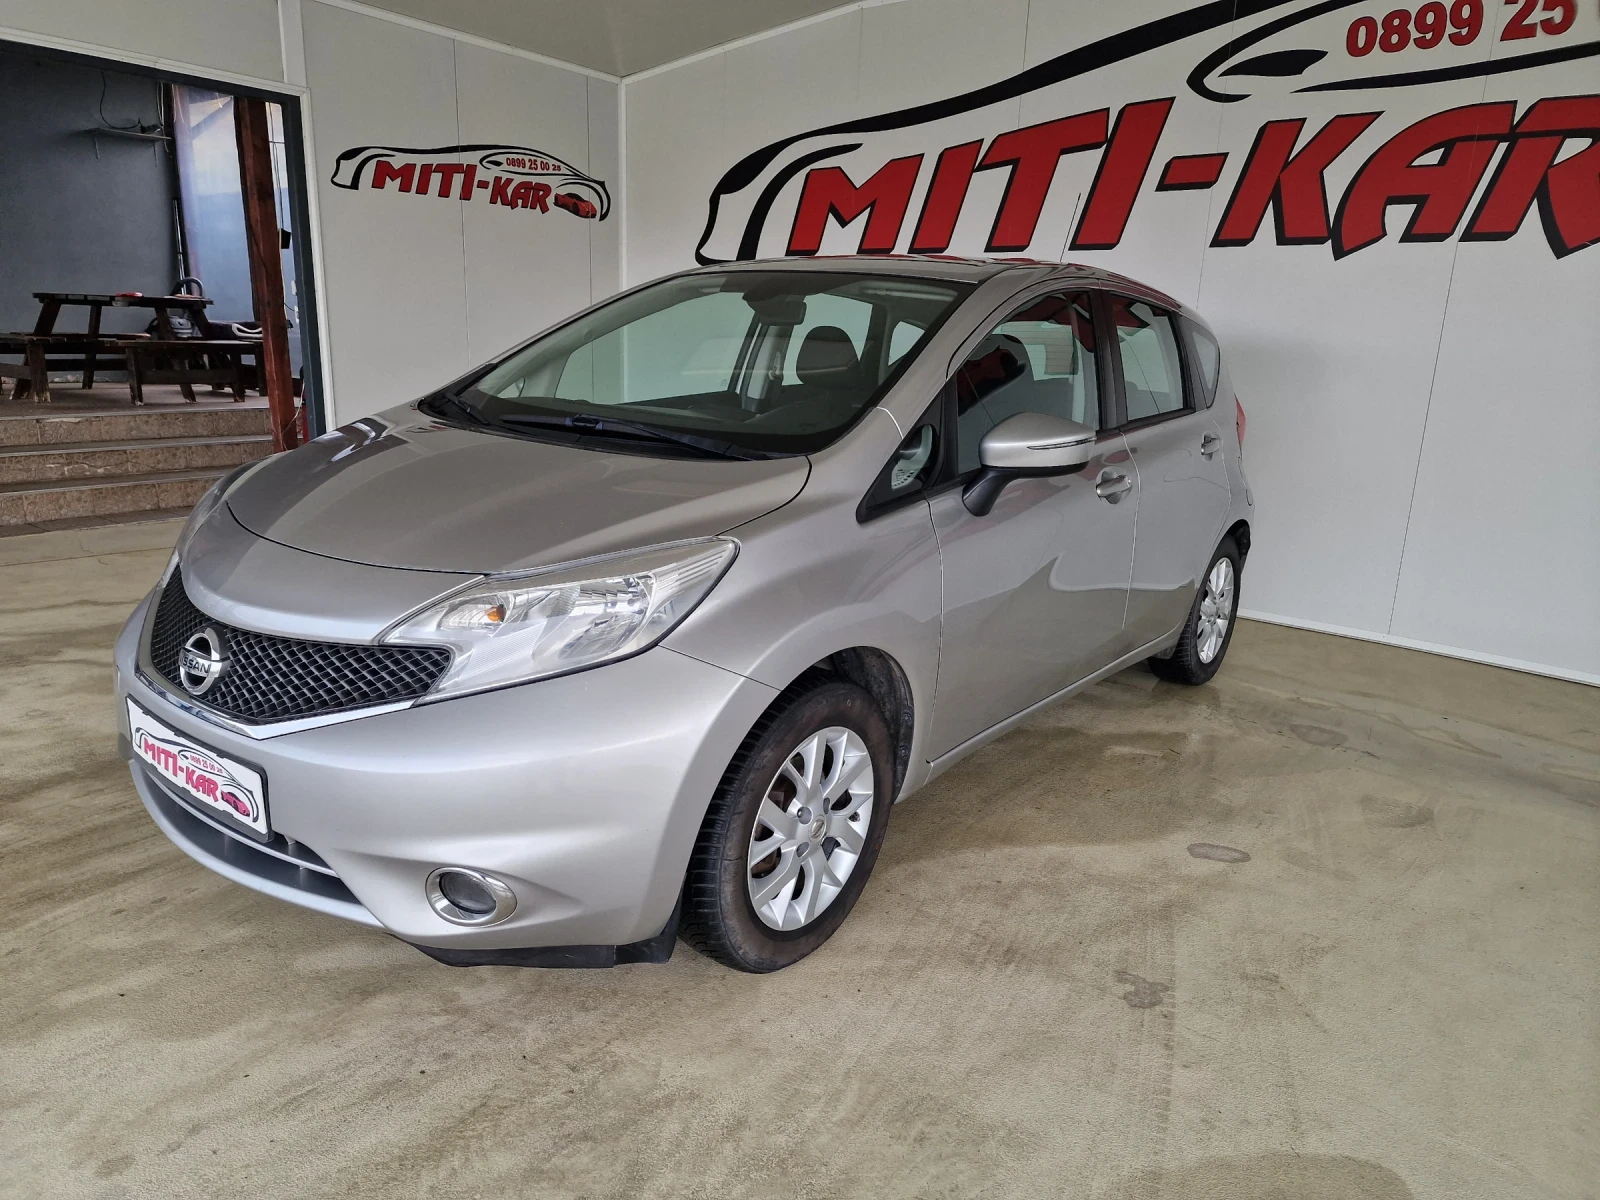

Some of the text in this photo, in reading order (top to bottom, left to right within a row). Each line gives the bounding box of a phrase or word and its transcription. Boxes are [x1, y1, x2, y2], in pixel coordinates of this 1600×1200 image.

[1346, 0, 1578, 57] 0899 25
[371, 159, 552, 215] MITI-KAR
[506, 157, 562, 171] 0899 25 00 25
[785, 94, 1600, 261] MITI-KAR
[180, 652, 212, 674] SSAN
[144, 738, 219, 802] MITI-KAR
